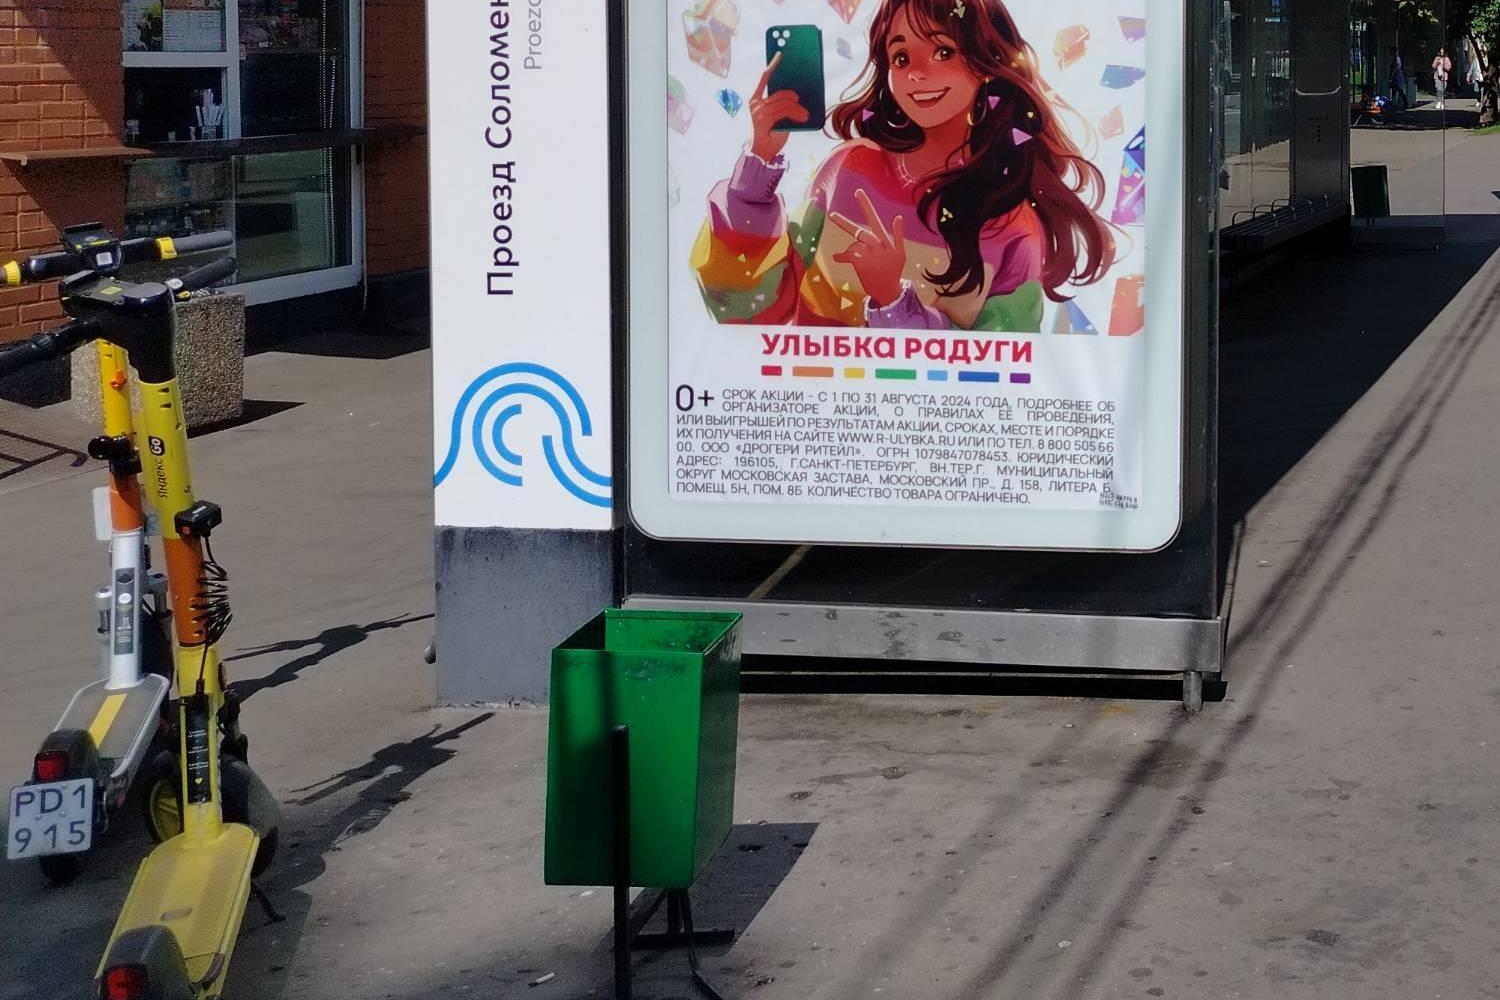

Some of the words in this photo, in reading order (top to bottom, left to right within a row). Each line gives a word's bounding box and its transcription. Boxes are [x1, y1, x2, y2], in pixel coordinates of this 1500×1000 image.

[487, 161, 519, 295] Проезд
[676, 384, 714, 411] 0+
[722, 389, 757, 400] СРОК
[761, 390, 804, 402] АКЦИИ
[818, 391, 828, 402] С
[832, 392, 837, 402] 1
[842, 392, 861, 403] ПО
[865, 393, 877, 404] 31
[881, 393, 937, 406] АВГУСТА
[941, 395, 971, 407] 2024
[1017, 397, 1092, 412] ПОДРОБНЕЕ
[1097, 400, 1115, 412] ОБ
[722, 401, 820, 415] ОРГАНИЗАТОРЕ
[894, 406, 904, 418] О
[918, 407, 985, 420] ПРАВИЛАХ
[1027, 411, 1115, 426] ПРОВЕДЕНИЯ,
[676, 414, 703, 426] ИЛИ
[706, 414, 786, 428] ВЫИГРЫШЕЙ
[787, 417, 806, 428] ПО
[808, 418, 896, 431] РЕЗУЛЬТАТАМ
[1001, 425, 1042, 436] МЕСТЕ
[1045, 425, 1054, 437] И
[1056, 426, 1115, 440] ПОРЯДКЕ
[677, 429, 694, 439] ИХ
[695, 428, 772, 441] ПОЛУЧЕНИЯ
[774, 431, 792, 442] НА
[794, 429, 835, 443] САЙТЕ
[958, 436, 985, 448] ИЛИ
[987, 437, 1006, 448] ПО
[1008, 438, 1034, 450] ТЕЛ.
[1037, 439, 1045, 450] 8
[1047, 439, 1071, 451] 800
[1074, 440, 1096, 451] 505
[1098, 441, 1114, 453] 66
[701, 442, 730, 453] ООО
[876, 447, 910, 459] ОГРН
[1017, 450, 1114, 467] ЮРИДИЧЕСКИЙ
[156, 458, 168, 498] Яндекс
[676, 455, 722, 467] АДРЕС:
[997, 465, 1114, 482] МУНИЦИПАЛЬНЫЙ
[676, 469, 716, 481] ОКРУГ
[721, 469, 808, 483] МОСКОВСКАЯ
[879, 473, 967, 488] МОСКОВСКИЙ
[1048, 480, 1097, 493] ЛИТЕРА
[787, 485, 803, 496] 8Б
[808, 486, 893, 499] КОЛИЧЕСТВО
[894, 488, 943, 501] ТОВАРА
[945, 490, 1031, 505] ОГРАНИЧЕНО.
[15, 820, 86, 854] 915
